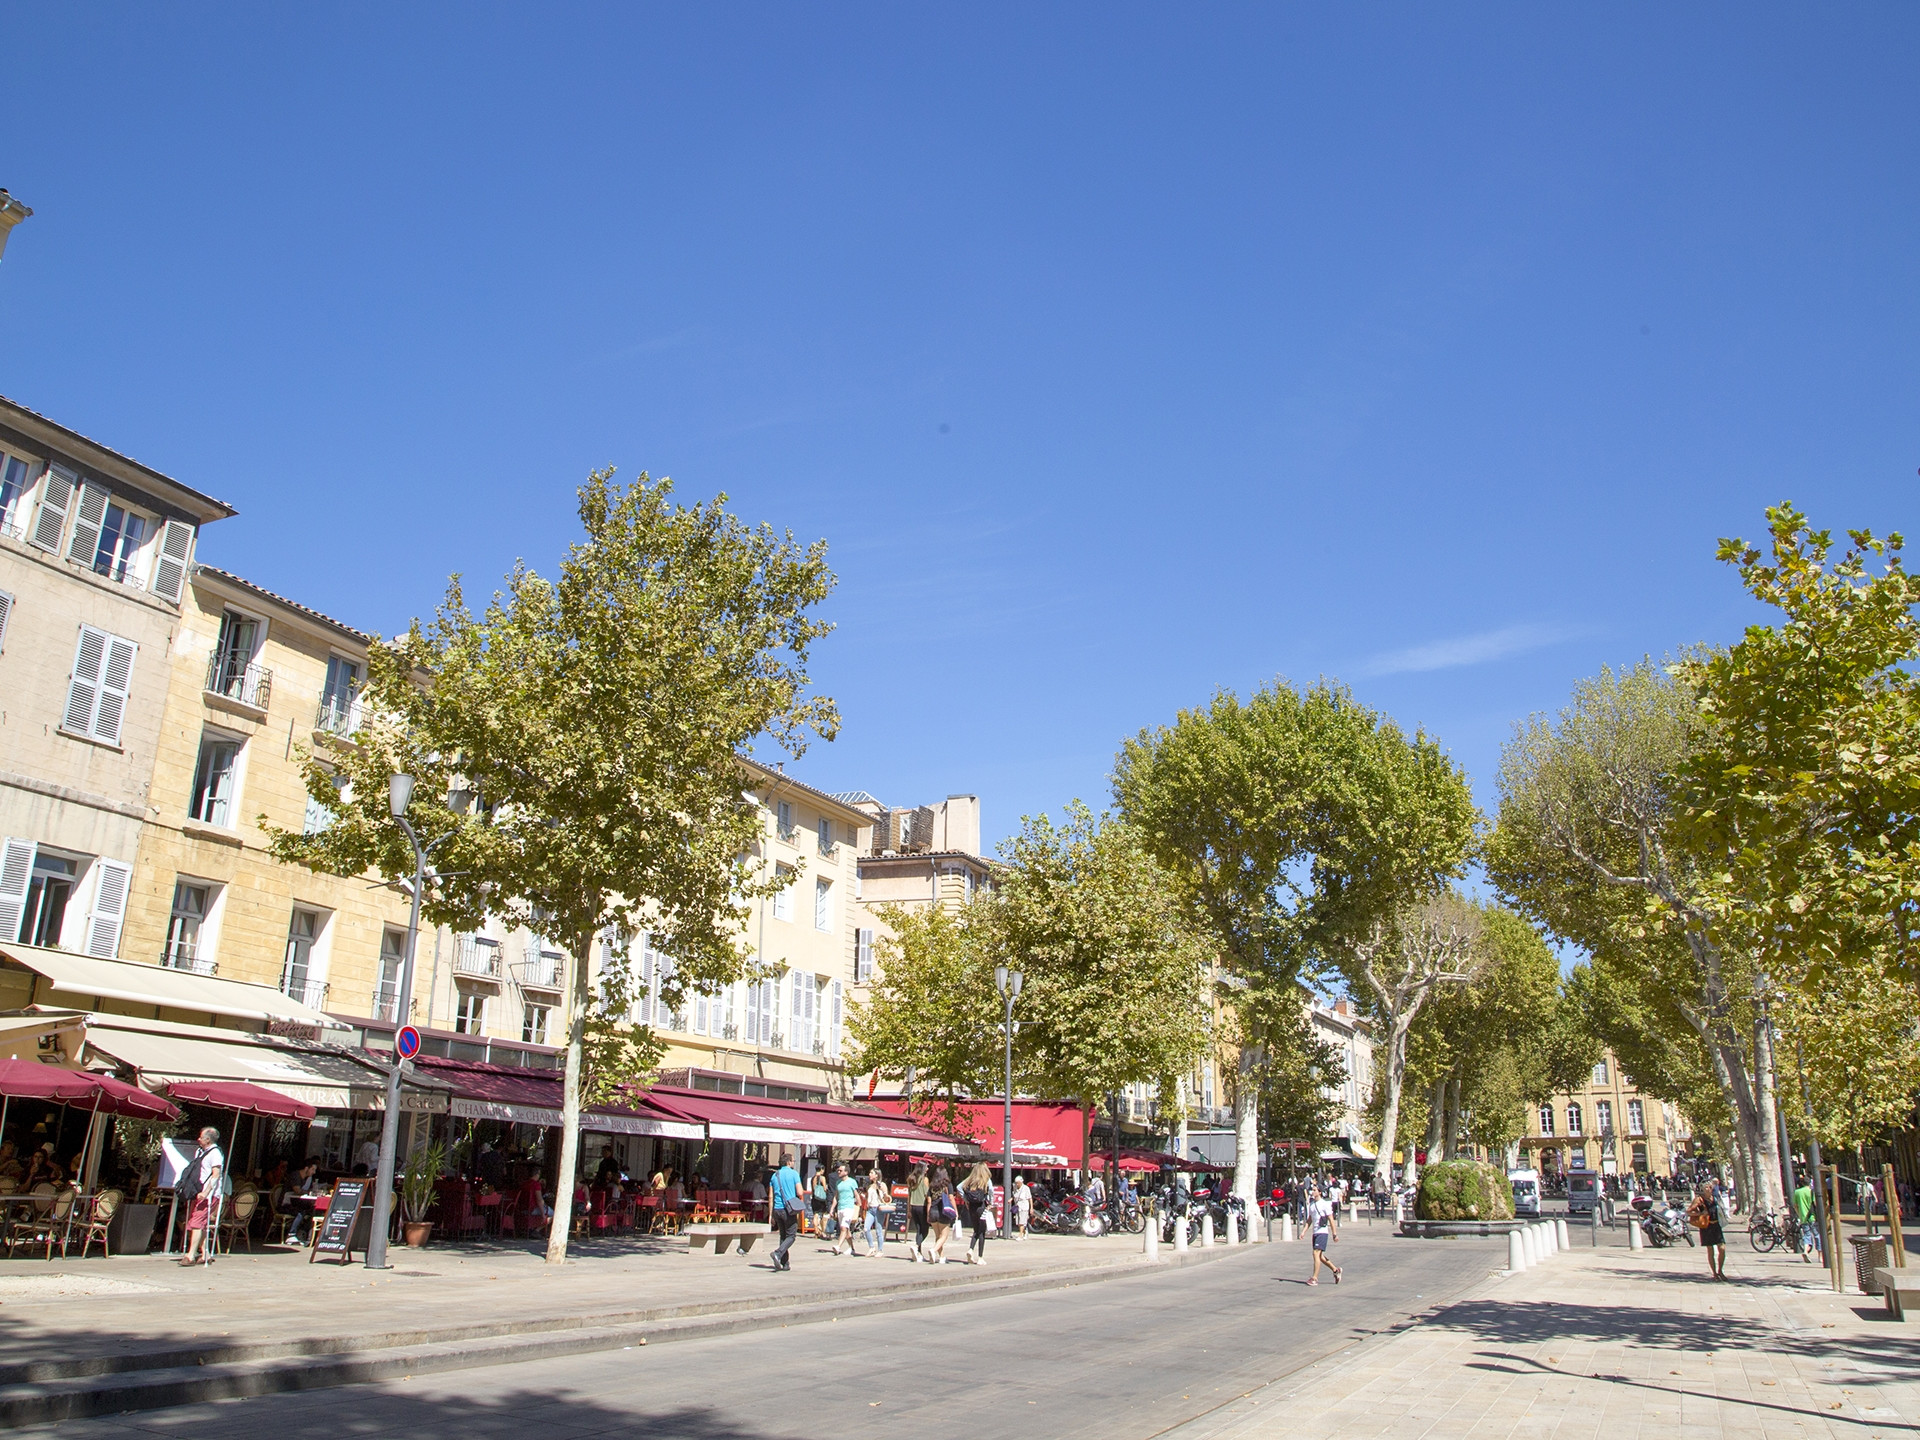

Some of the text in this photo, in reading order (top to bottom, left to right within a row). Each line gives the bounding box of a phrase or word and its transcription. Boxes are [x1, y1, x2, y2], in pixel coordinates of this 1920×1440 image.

[406, 1097, 436, 1109] Café
[526, 1111, 564, 1124] CHARM
[611, 1120, 652, 1133] BRASSERIE
